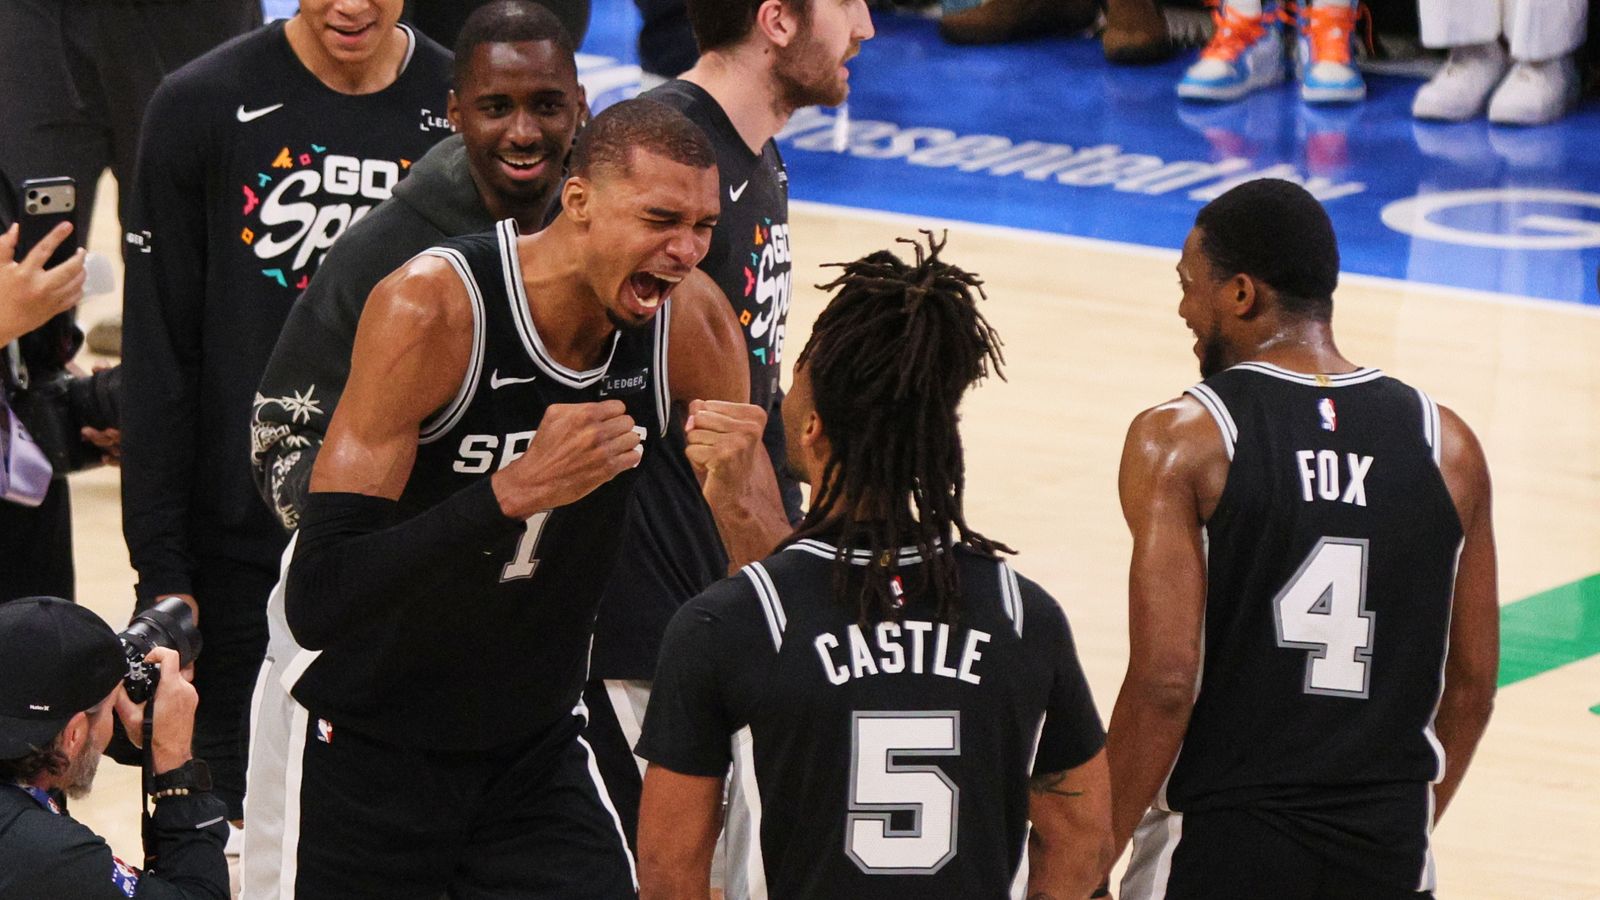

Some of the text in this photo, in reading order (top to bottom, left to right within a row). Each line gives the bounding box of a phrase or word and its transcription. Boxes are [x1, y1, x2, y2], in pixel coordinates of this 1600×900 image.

[323, 154, 399, 200] GO
[607, 375, 643, 390] LEDGER
[1296, 449, 1374, 507] FOX
[500, 508, 553, 583] 1
[1273, 536, 1376, 699] 4
[814, 619, 991, 685] CASTLE
[845, 710, 961, 875] 5
